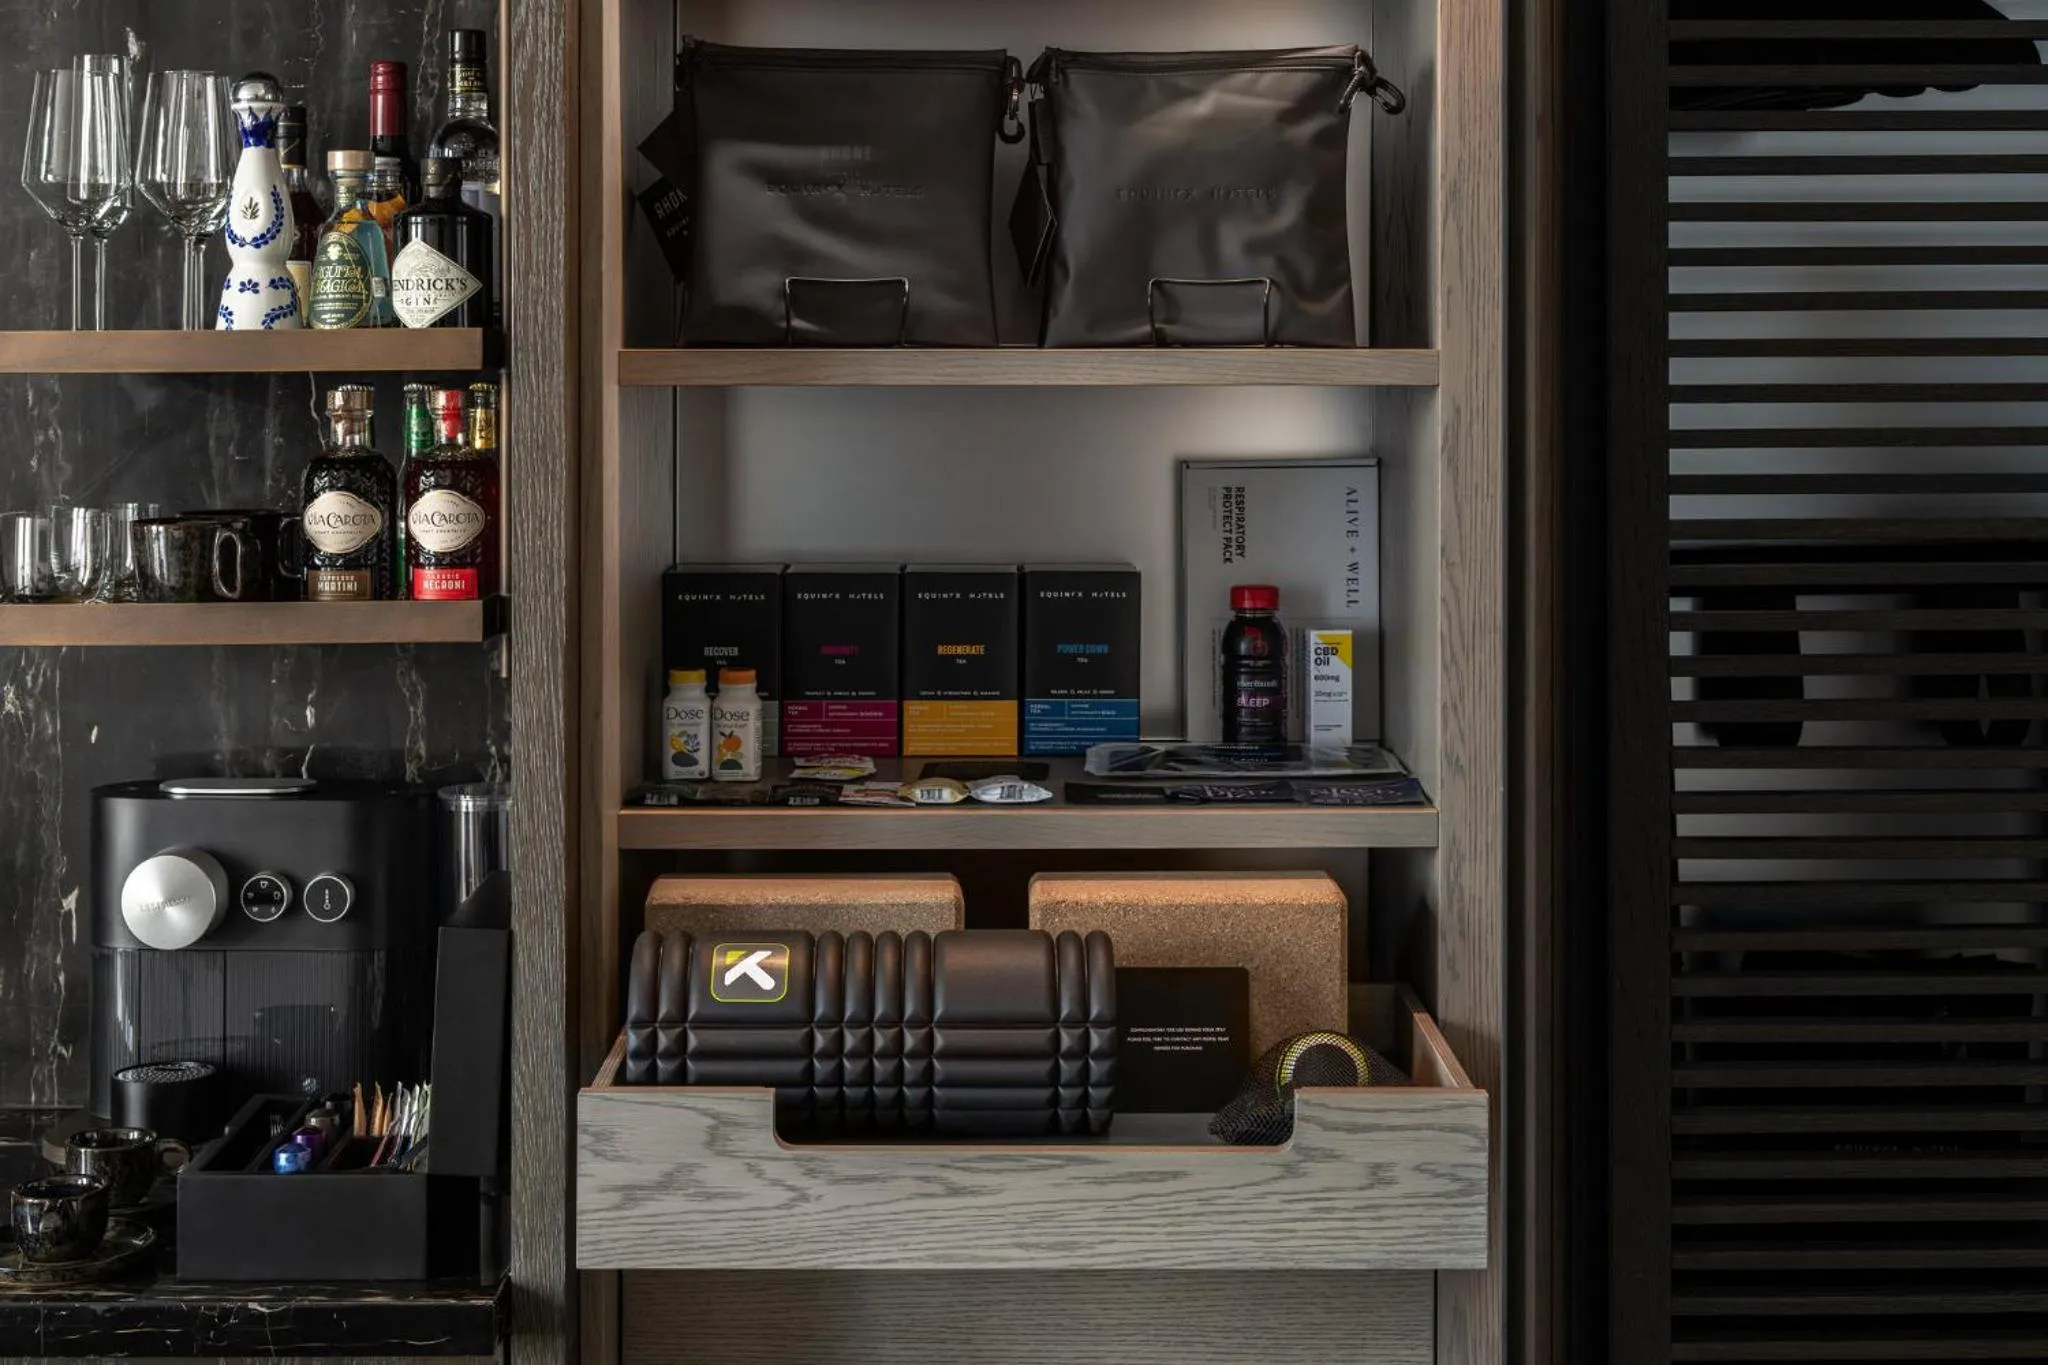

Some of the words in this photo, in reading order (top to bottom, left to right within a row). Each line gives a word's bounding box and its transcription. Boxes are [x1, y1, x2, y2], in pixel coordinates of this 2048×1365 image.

[1222, 486, 1233, 535] PROTECT
[1346, 486, 1359, 538] ALIVE
[1235, 486, 1246, 558] RESPIRATORY
[1222, 536, 1234, 564] PACK
[317, 581, 357, 592] MARTINI
[423, 580, 465, 590] NEGRONI
[1346, 560, 1360, 608] WELL
[704, 646, 739, 656] RECOVER
[937, 644, 986, 655] REGENERATE
[1314, 646, 1339, 656] CBD
[1314, 657, 1331, 667] Oil
[1237, 697, 1270, 708] SLEEP
[666, 707, 705, 721] Dose
[714, 707, 750, 722] Dose
